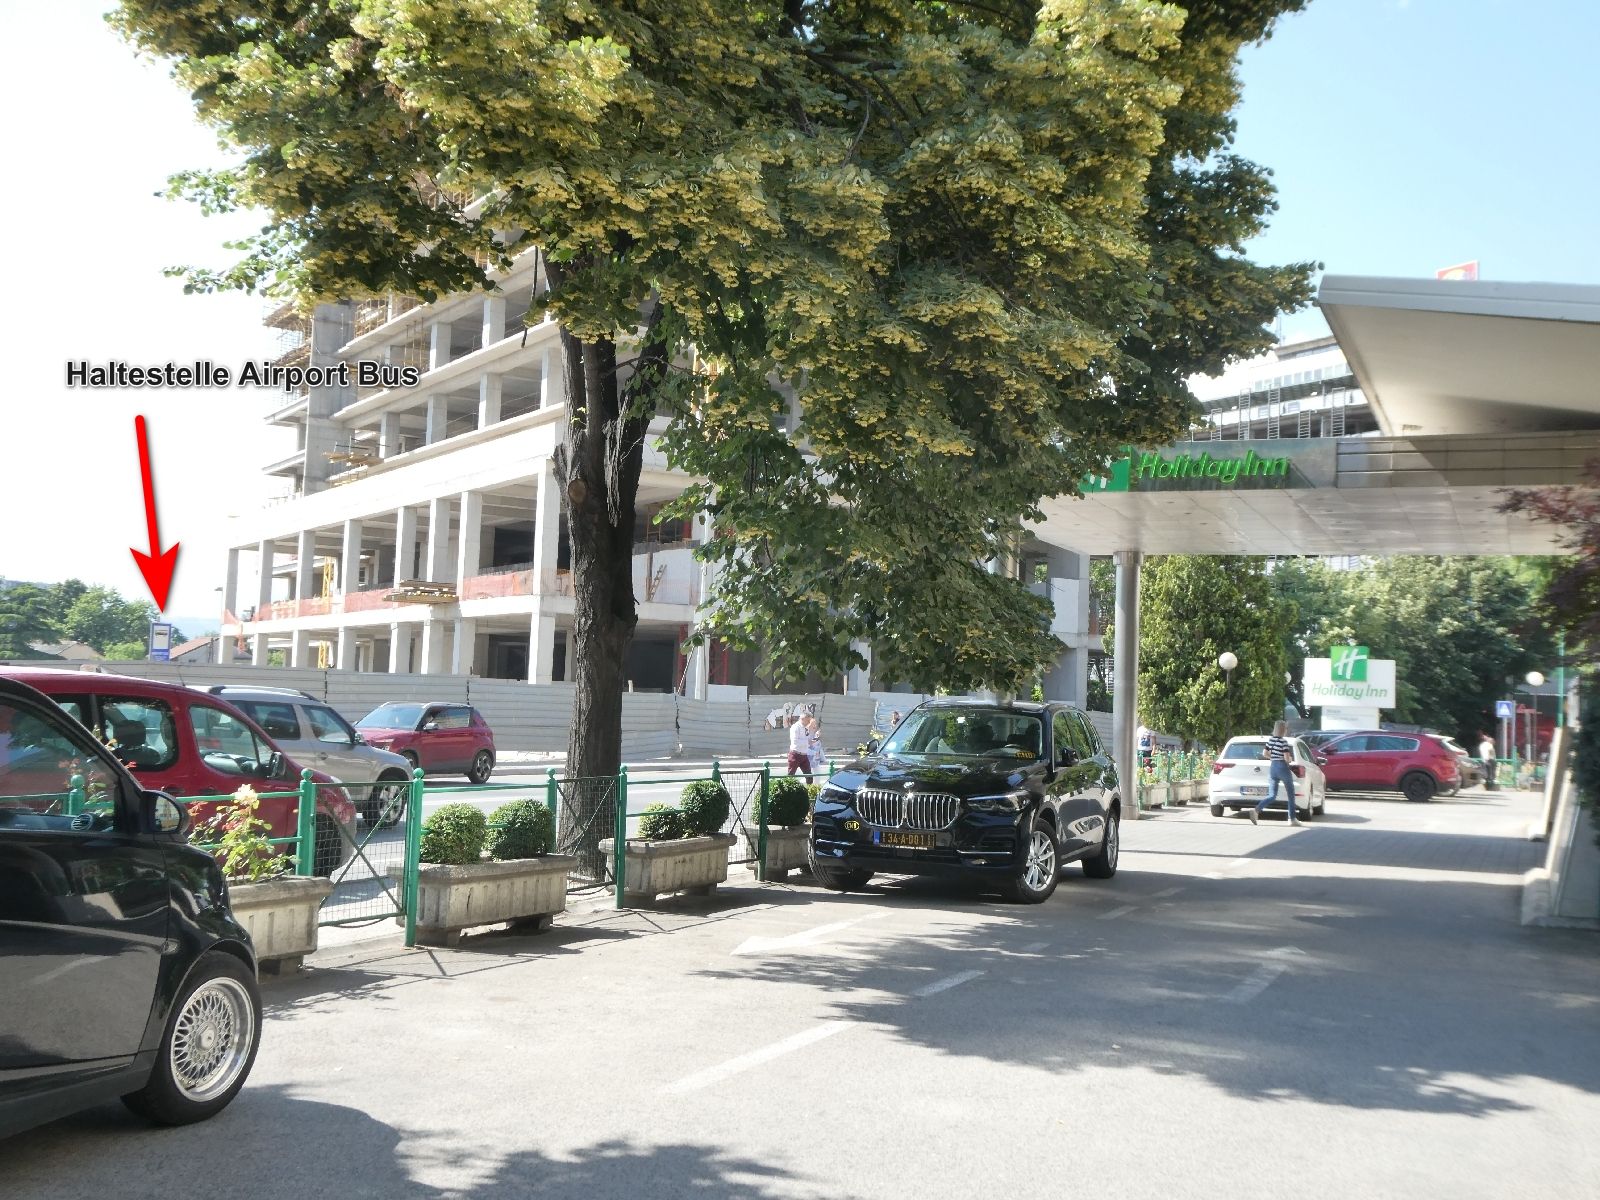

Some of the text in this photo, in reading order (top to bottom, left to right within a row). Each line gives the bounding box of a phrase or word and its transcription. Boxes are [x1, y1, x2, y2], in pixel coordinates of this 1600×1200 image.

[1137, 449, 1290, 483] Holiday Inn
[1312, 682, 1387, 700] Holiday Inn
